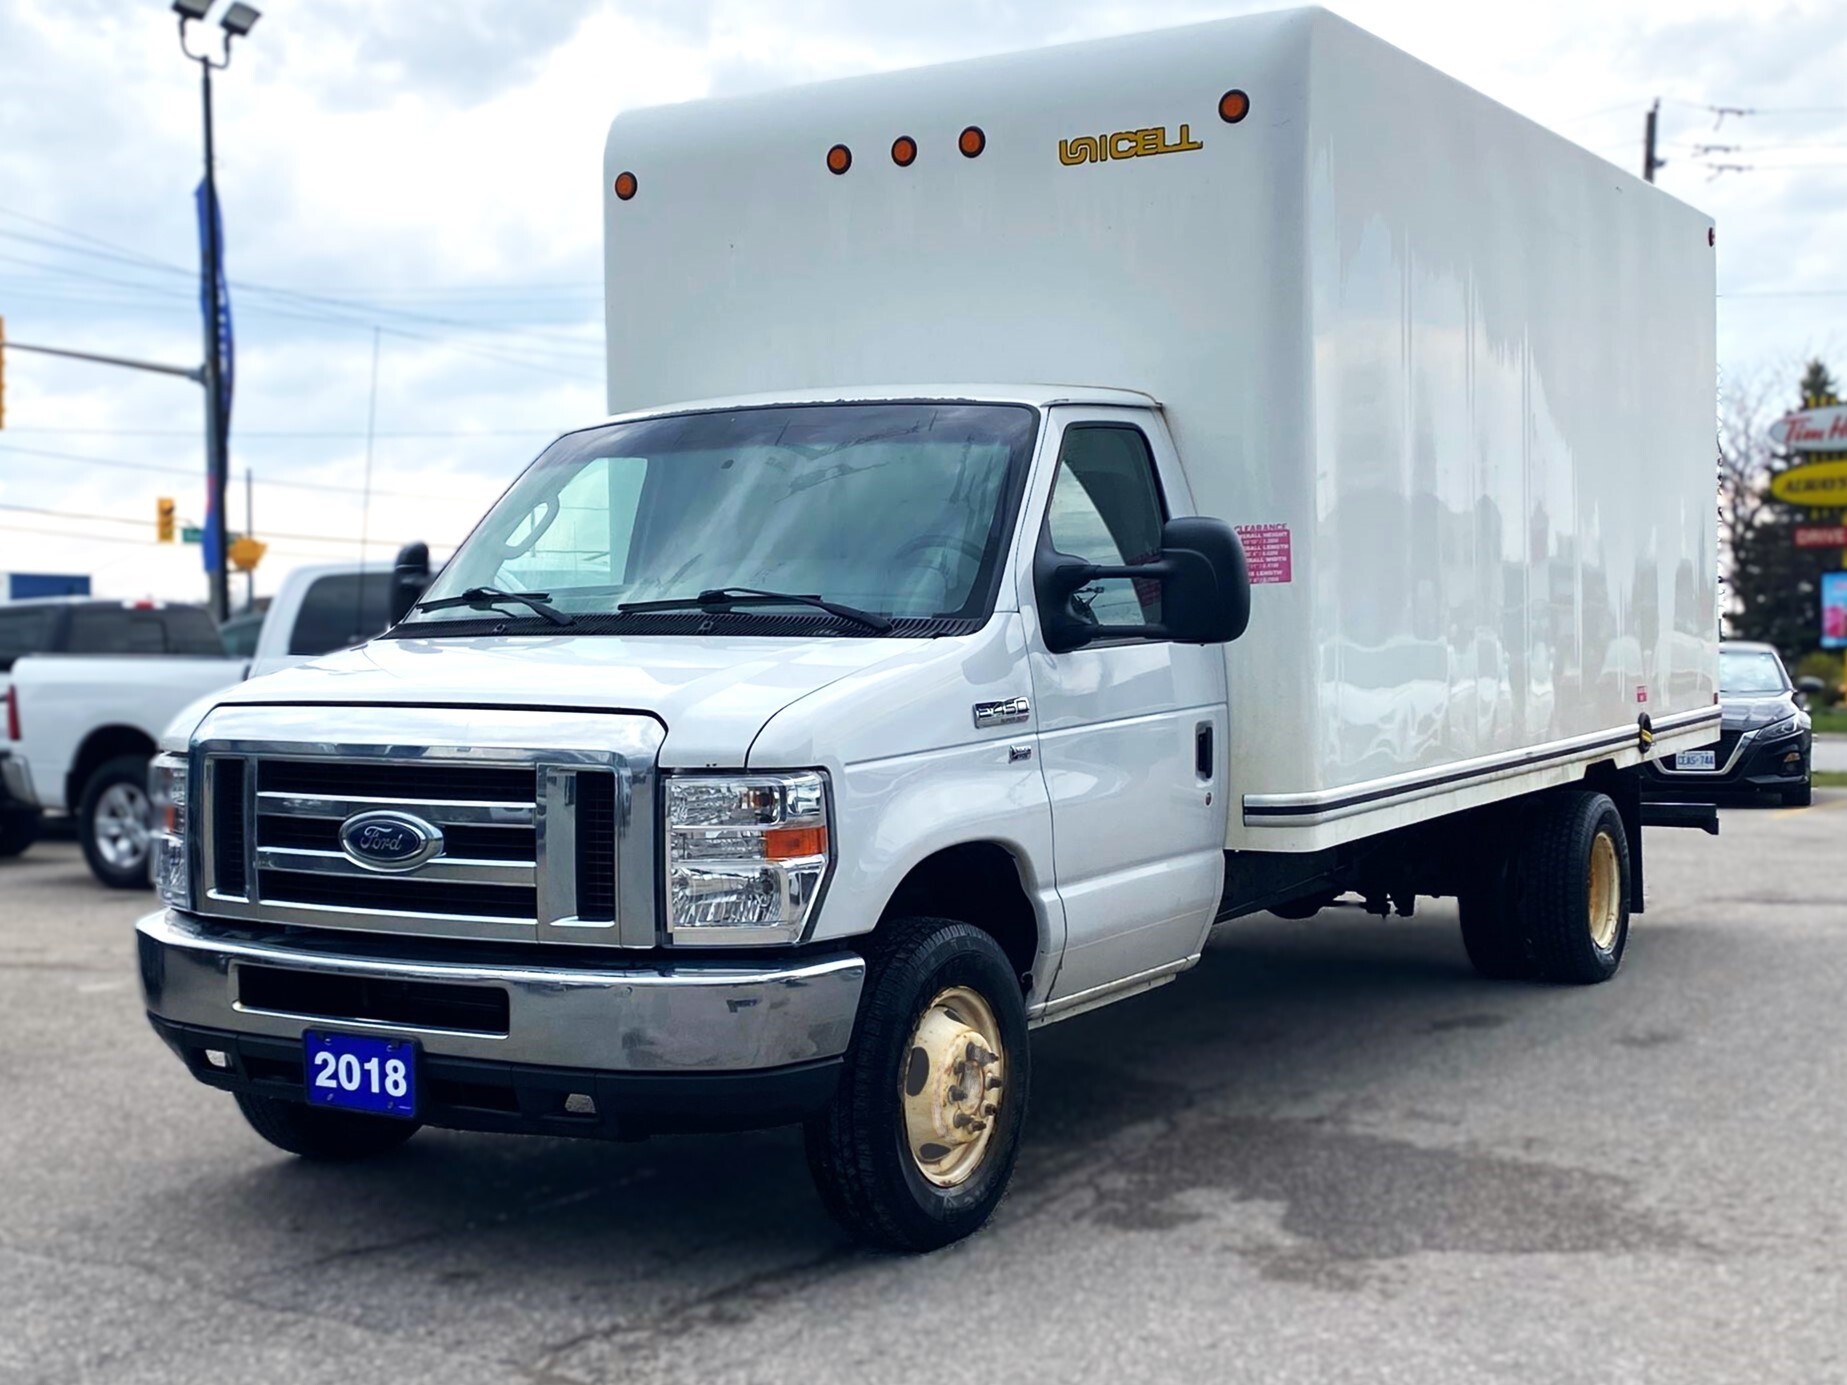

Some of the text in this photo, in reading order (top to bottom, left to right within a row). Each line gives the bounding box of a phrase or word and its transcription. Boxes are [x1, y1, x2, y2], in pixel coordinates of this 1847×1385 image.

[1058, 124, 1203, 166] UNICELL
[1783, 416, 1825, 442] Tim
[1234, 523, 1287, 532] CLEARANCE
[1795, 527, 1845, 545] DRIVE
[359, 825, 402, 851] Ford
[313, 1051, 407, 1097] 2018
